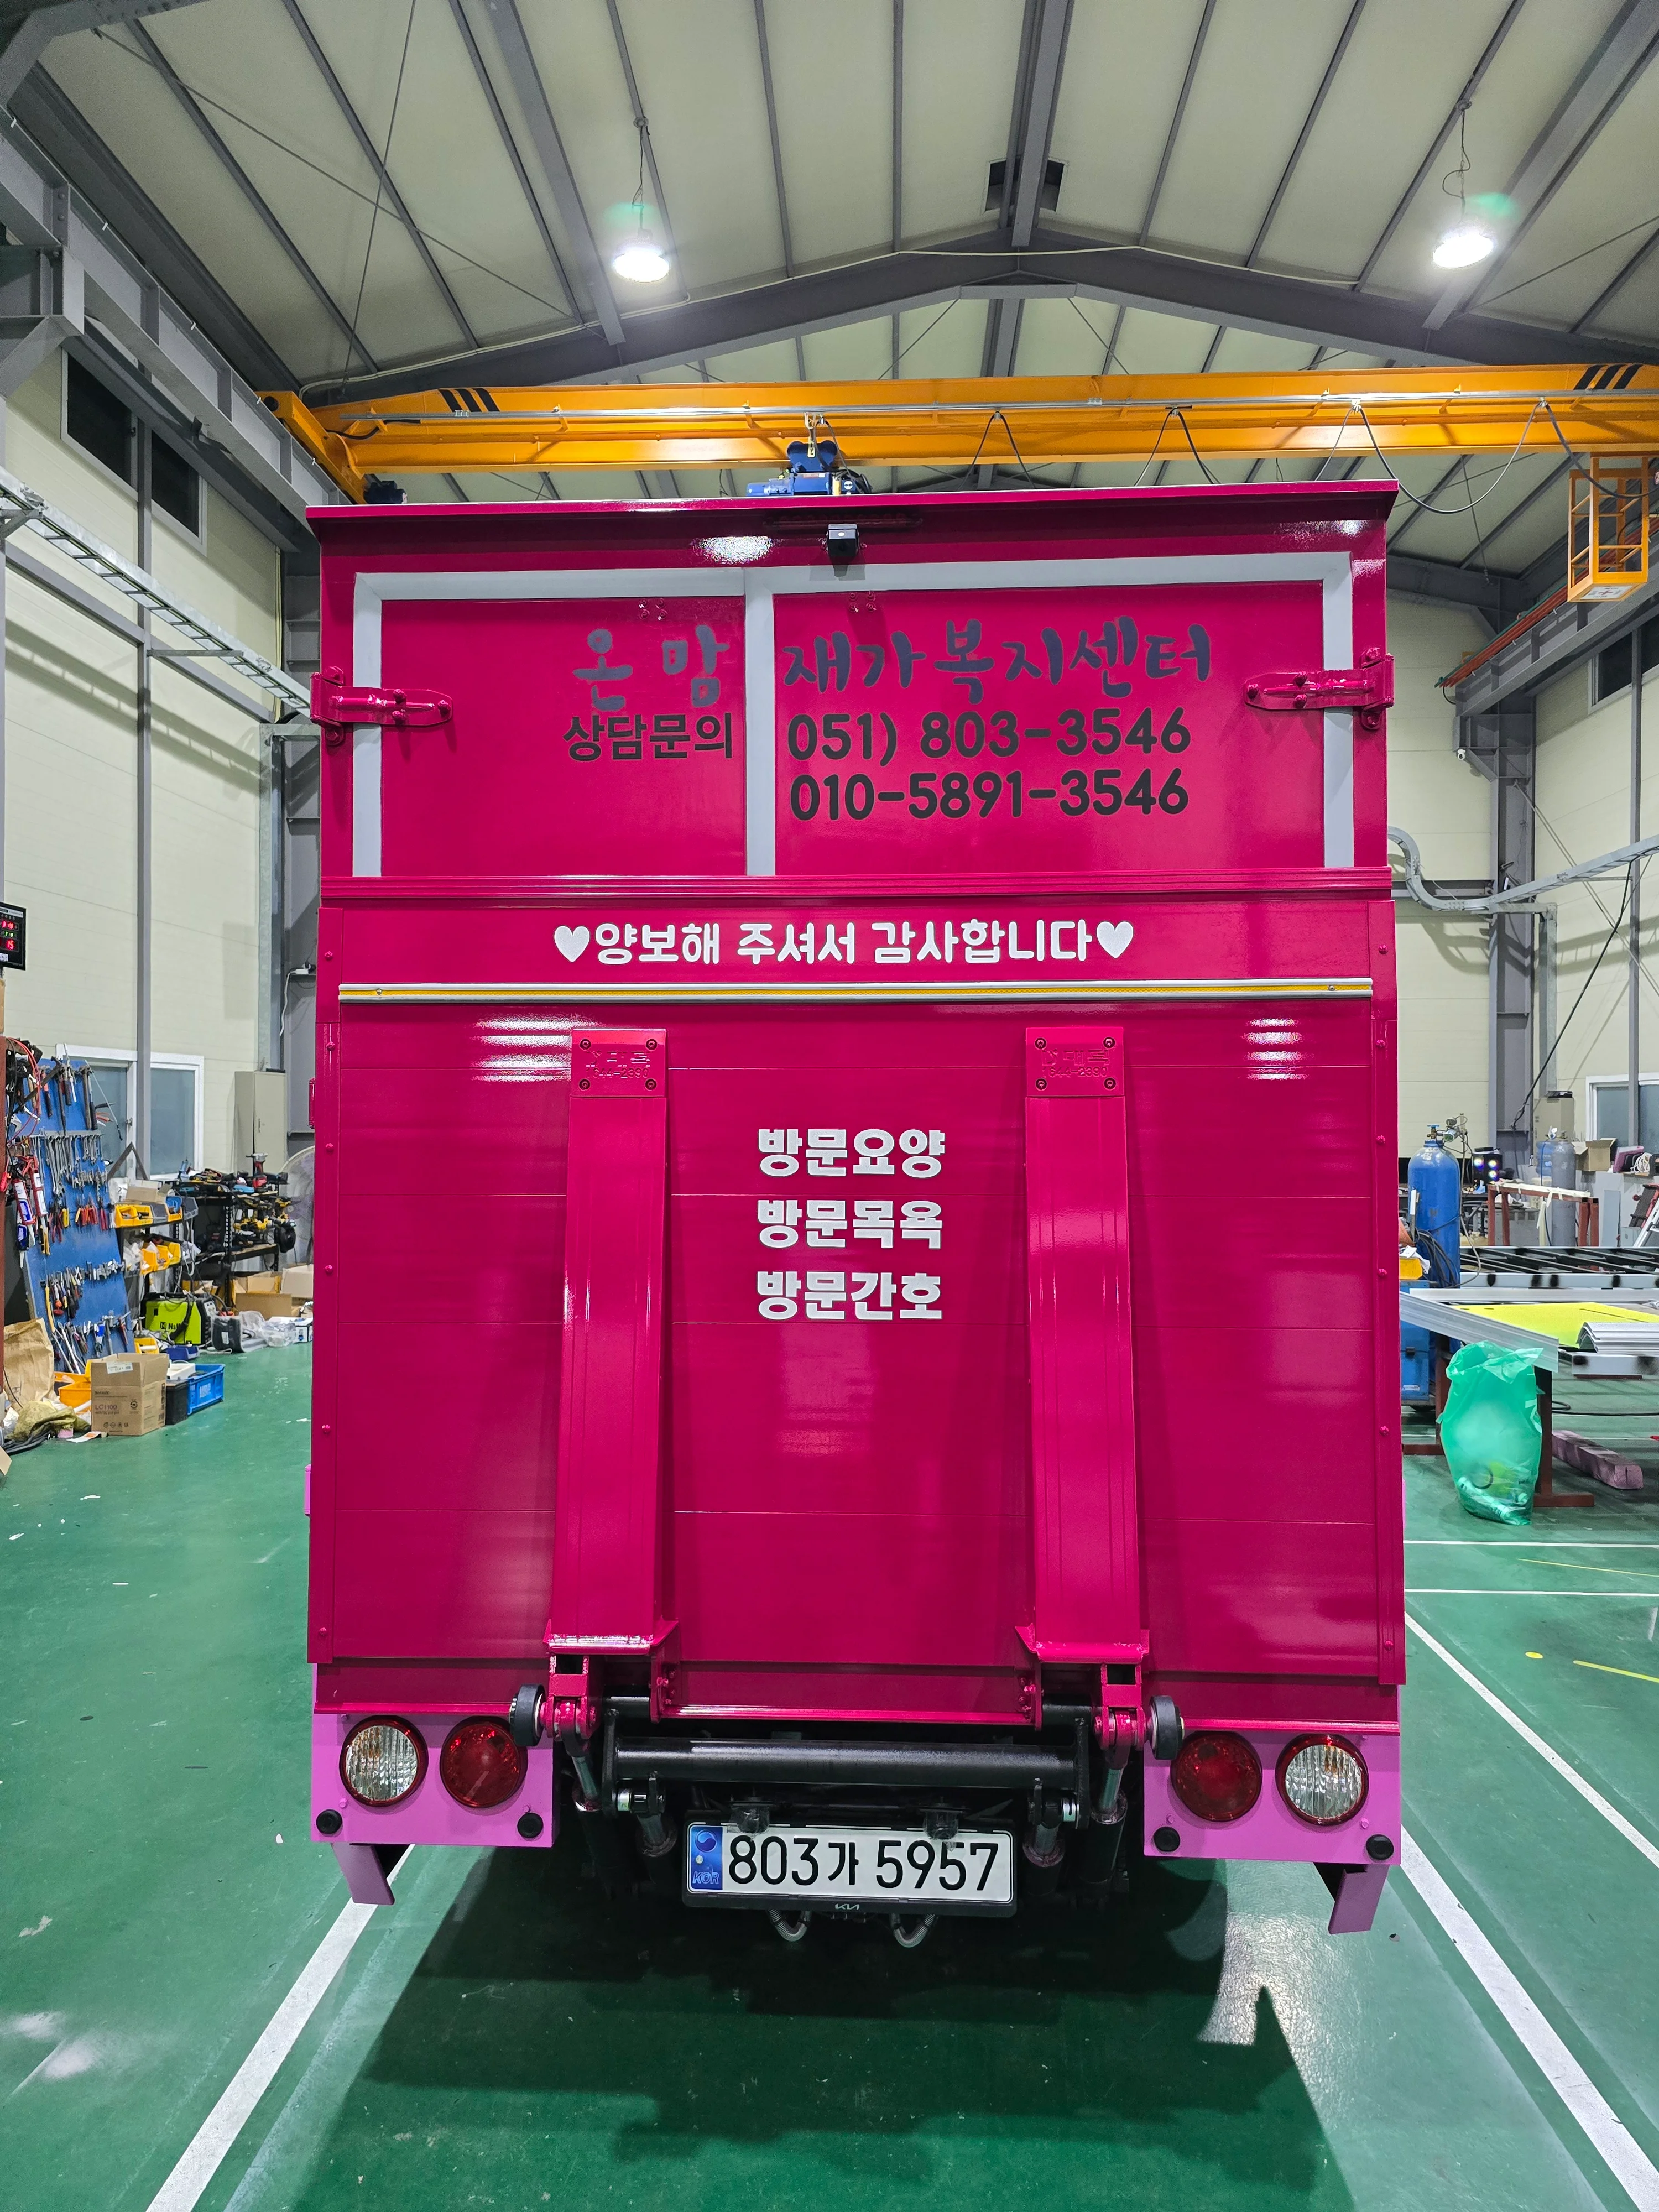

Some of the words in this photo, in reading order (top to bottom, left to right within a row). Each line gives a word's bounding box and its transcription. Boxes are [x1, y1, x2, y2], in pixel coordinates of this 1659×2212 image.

[563, 712, 732, 761] 상담문의
[787, 712, 897, 766] 051)
[921, 707, 1191, 758] 803-3546
[790, 768, 1188, 821] 010-5891-3546
[595, 922, 720, 965] 양보해
[737, 922, 854, 965] 주셔서
[871, 919, 1093, 964] 감사합니다
[758, 1129, 945, 1178] 방문요양
[758, 1199, 942, 1249] 방문목욕
[757, 1271, 942, 1321] 방문간호
[692, 1871, 719, 1885] KOR
[729, 1835, 859, 1886] 803가
[876, 1839, 999, 1891] 5957
